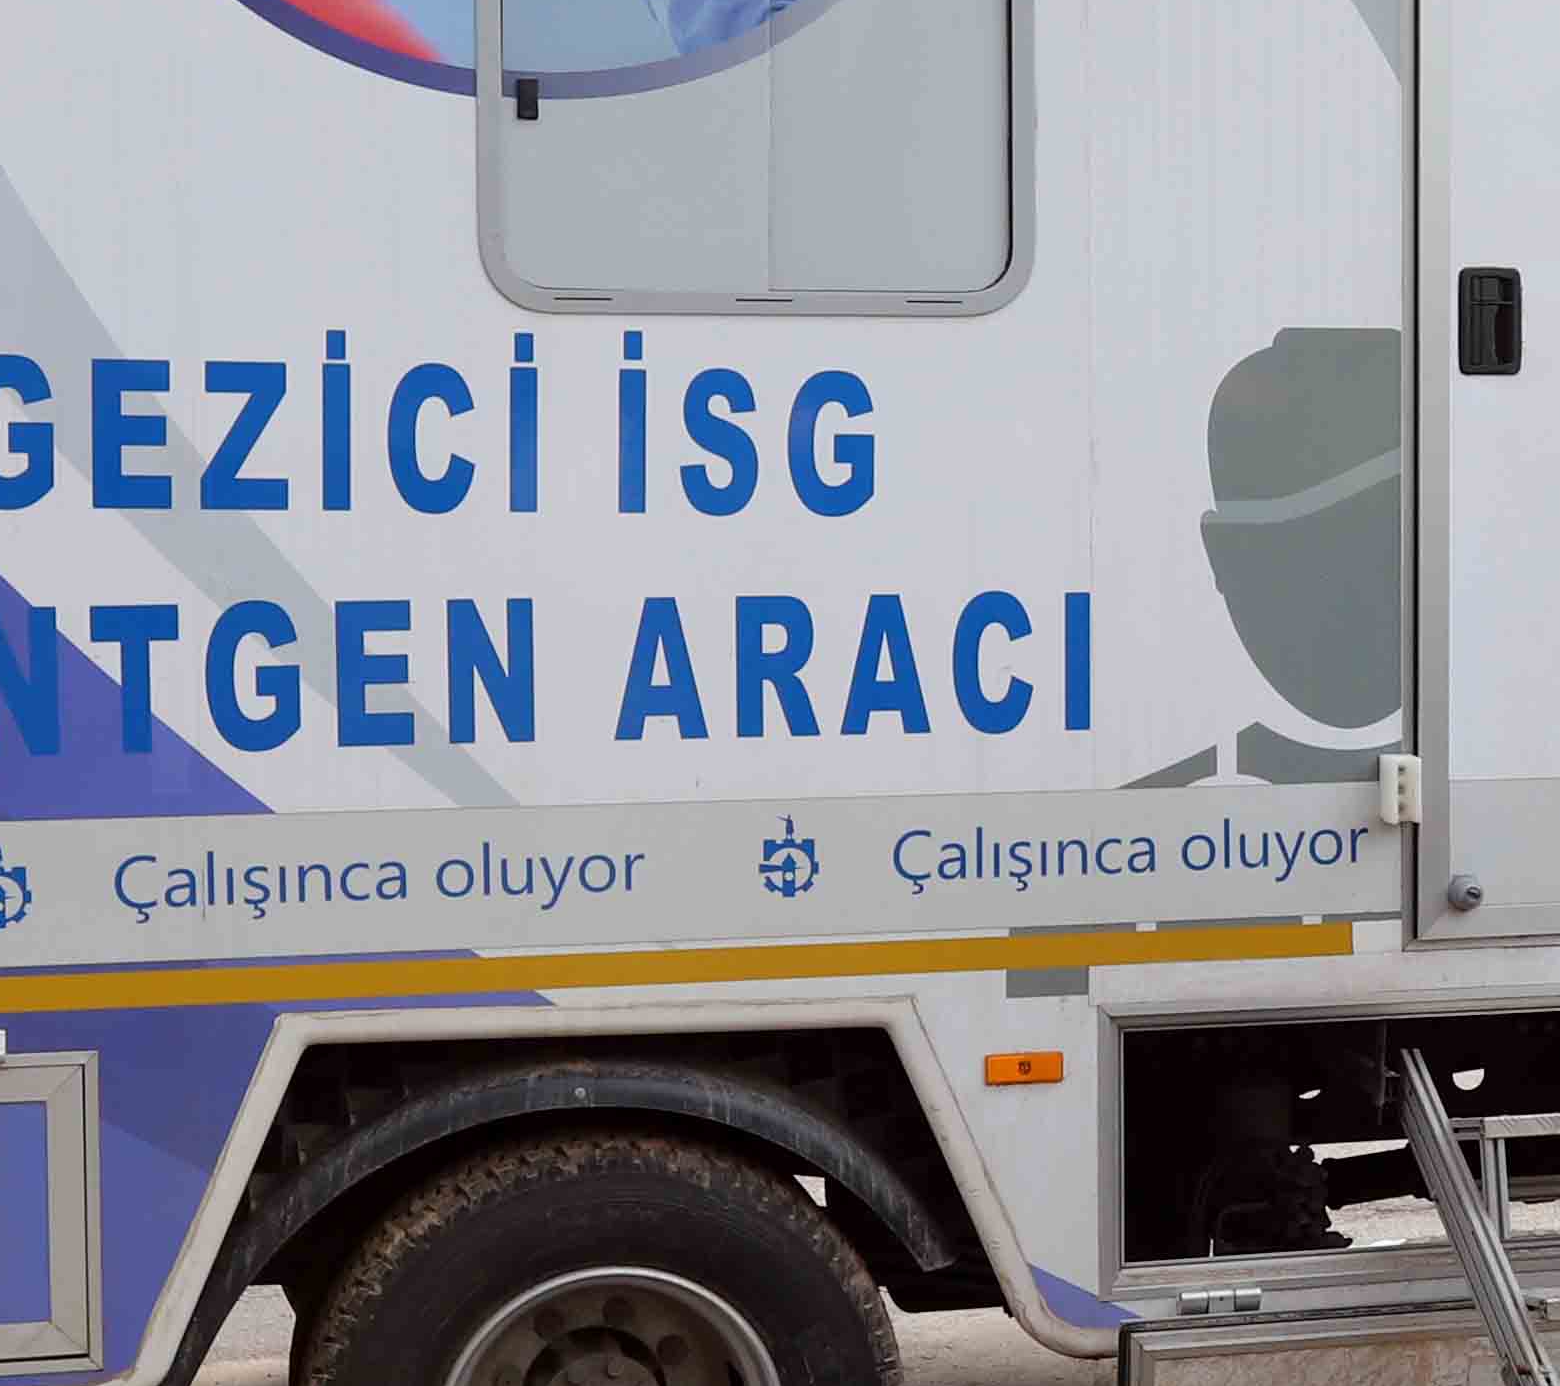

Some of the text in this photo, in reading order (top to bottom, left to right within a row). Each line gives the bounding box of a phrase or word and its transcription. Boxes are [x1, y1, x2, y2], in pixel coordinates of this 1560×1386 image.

[619, 329, 877, 518] İSG
[615, 591, 1092, 741] ARACI
[112, 841, 646, 924] Çalışınca oluyor
[892, 818, 1370, 894] Çalışınca oluyor
